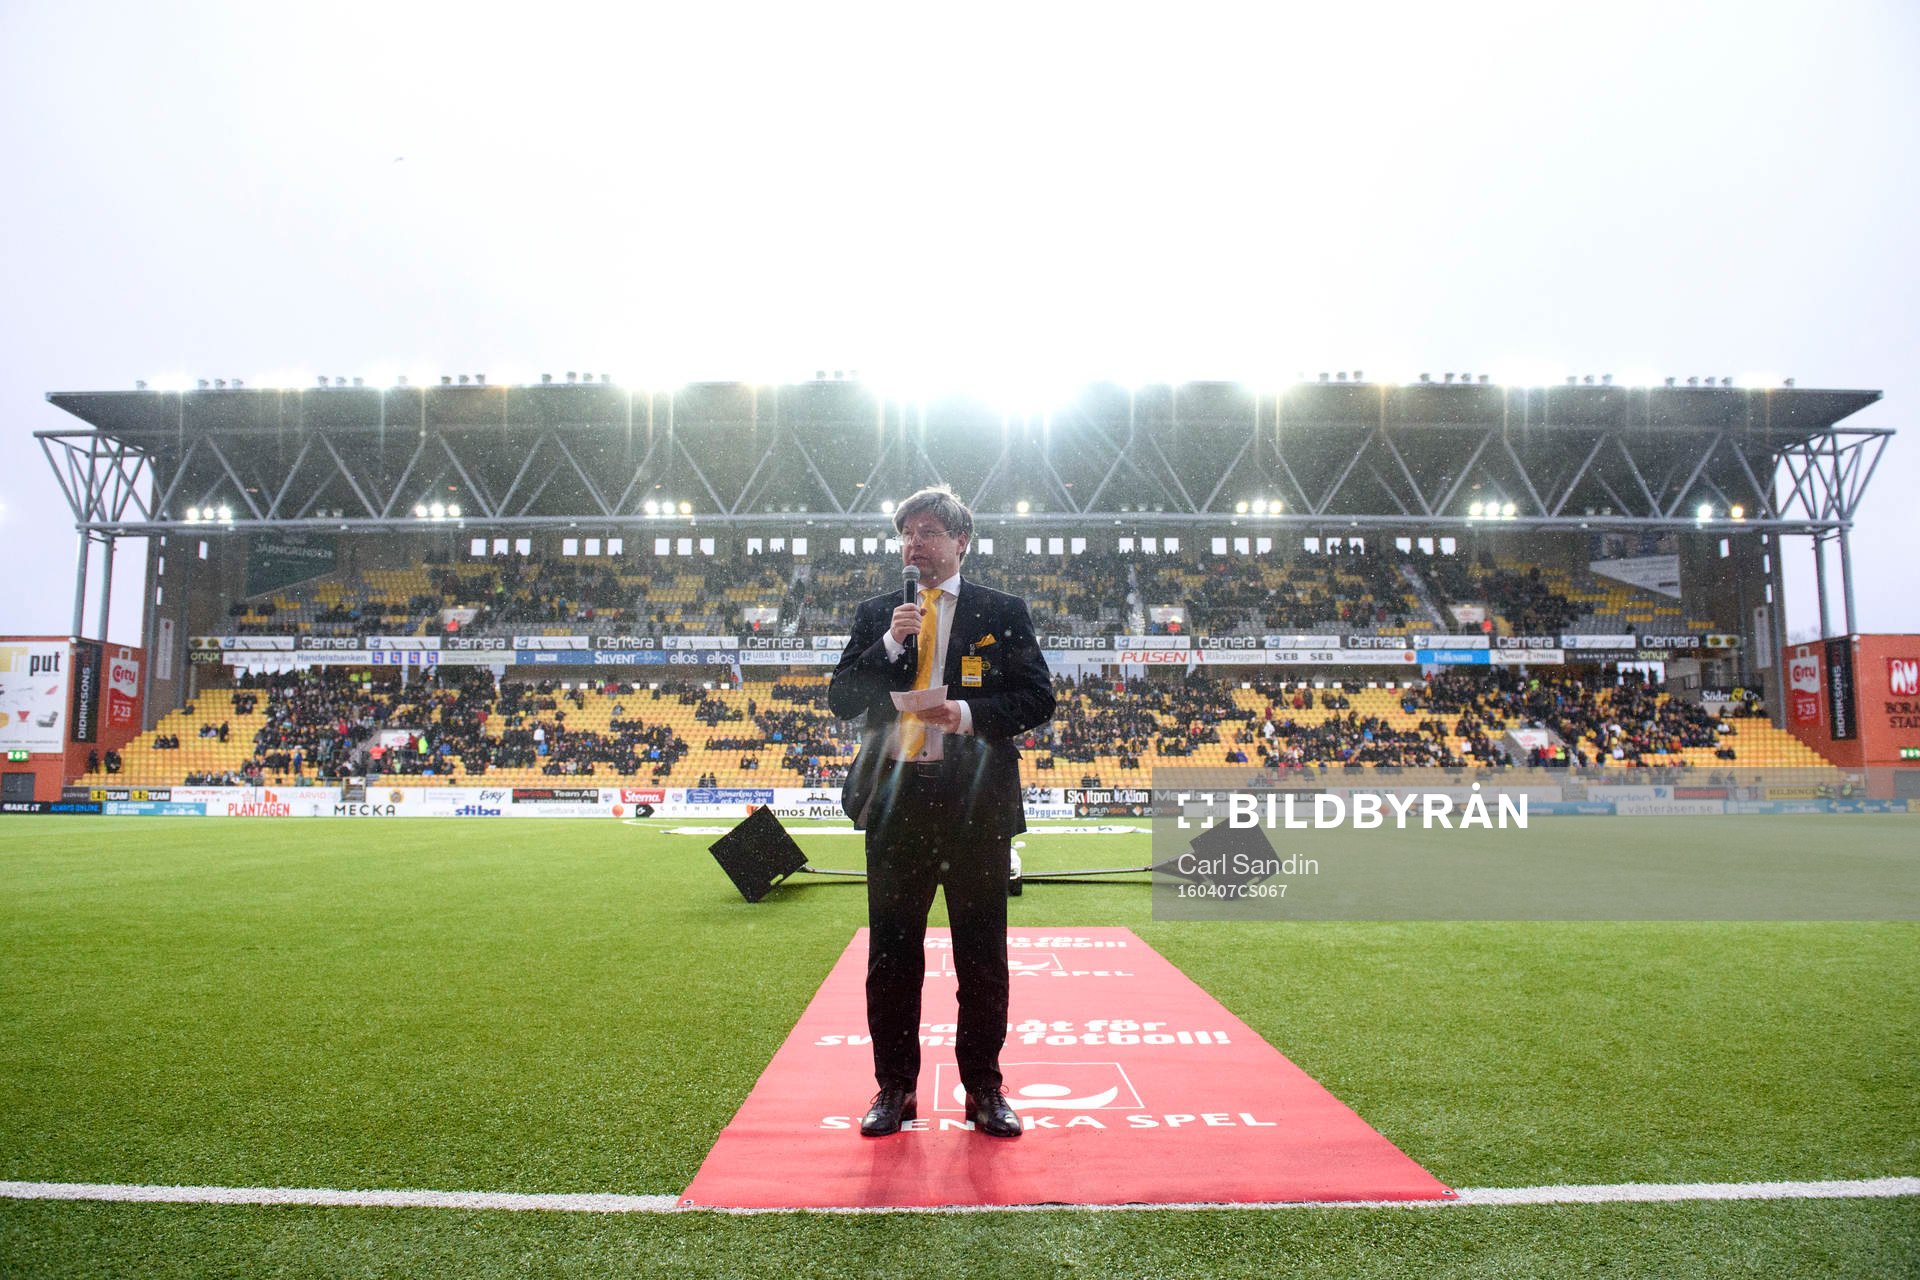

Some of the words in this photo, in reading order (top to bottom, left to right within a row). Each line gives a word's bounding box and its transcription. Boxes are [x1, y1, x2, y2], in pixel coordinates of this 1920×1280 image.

[297, 652, 367, 662] Handelsbanken
[669, 651, 698, 664] ellos
[707, 651, 735, 664] ellos
[1121, 651, 1188, 663] PULSEN
[30, 651, 60, 677] put
[78, 667, 92, 739] DIDRIKSONS
[1832, 666, 1847, 738] DIDRIKSONS
[106, 790, 129, 800] TEAM
[148, 790, 170, 800] TEAM
[3, 803, 29, 812] MAKE
[228, 803, 290, 816] PLANTAGEN
[334, 804, 396, 816] MECKA
[455, 805, 501, 816] stiba
[1084, 1019, 1168, 1032] för
[1023, 1031, 1232, 1046] fotboll!
[1125, 1112, 1278, 1129] SPEL
